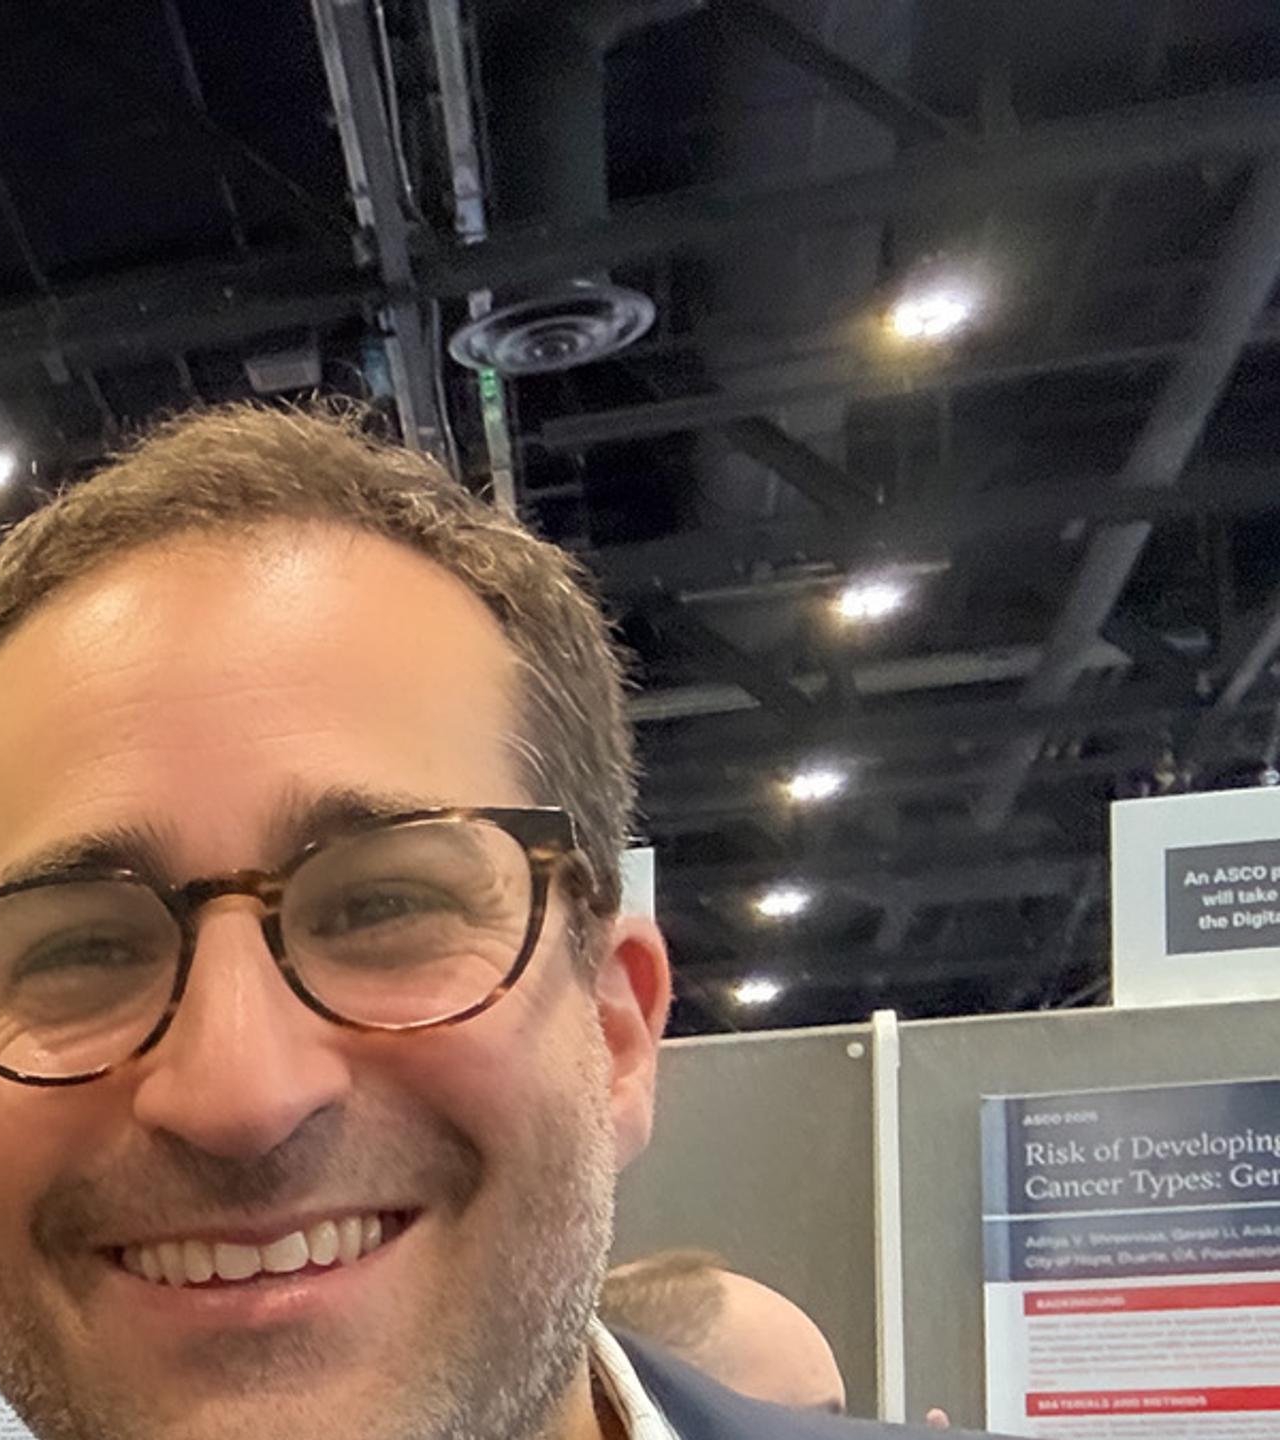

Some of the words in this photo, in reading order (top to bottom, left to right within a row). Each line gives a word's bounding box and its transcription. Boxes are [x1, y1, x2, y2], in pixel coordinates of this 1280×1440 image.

[1184, 870, 1210, 886] An
[1214, 865, 1267, 884] ASCO
[1202, 889, 1234, 906] will
[1238, 886, 1278, 904] take
[1198, 914, 1228, 929] the
[1024, 1140, 1086, 1166] Risk
[1093, 1137, 1123, 1162] of
[1024, 1174, 1124, 1200] Cancer
[1128, 1167, 1223, 1199] Types:
